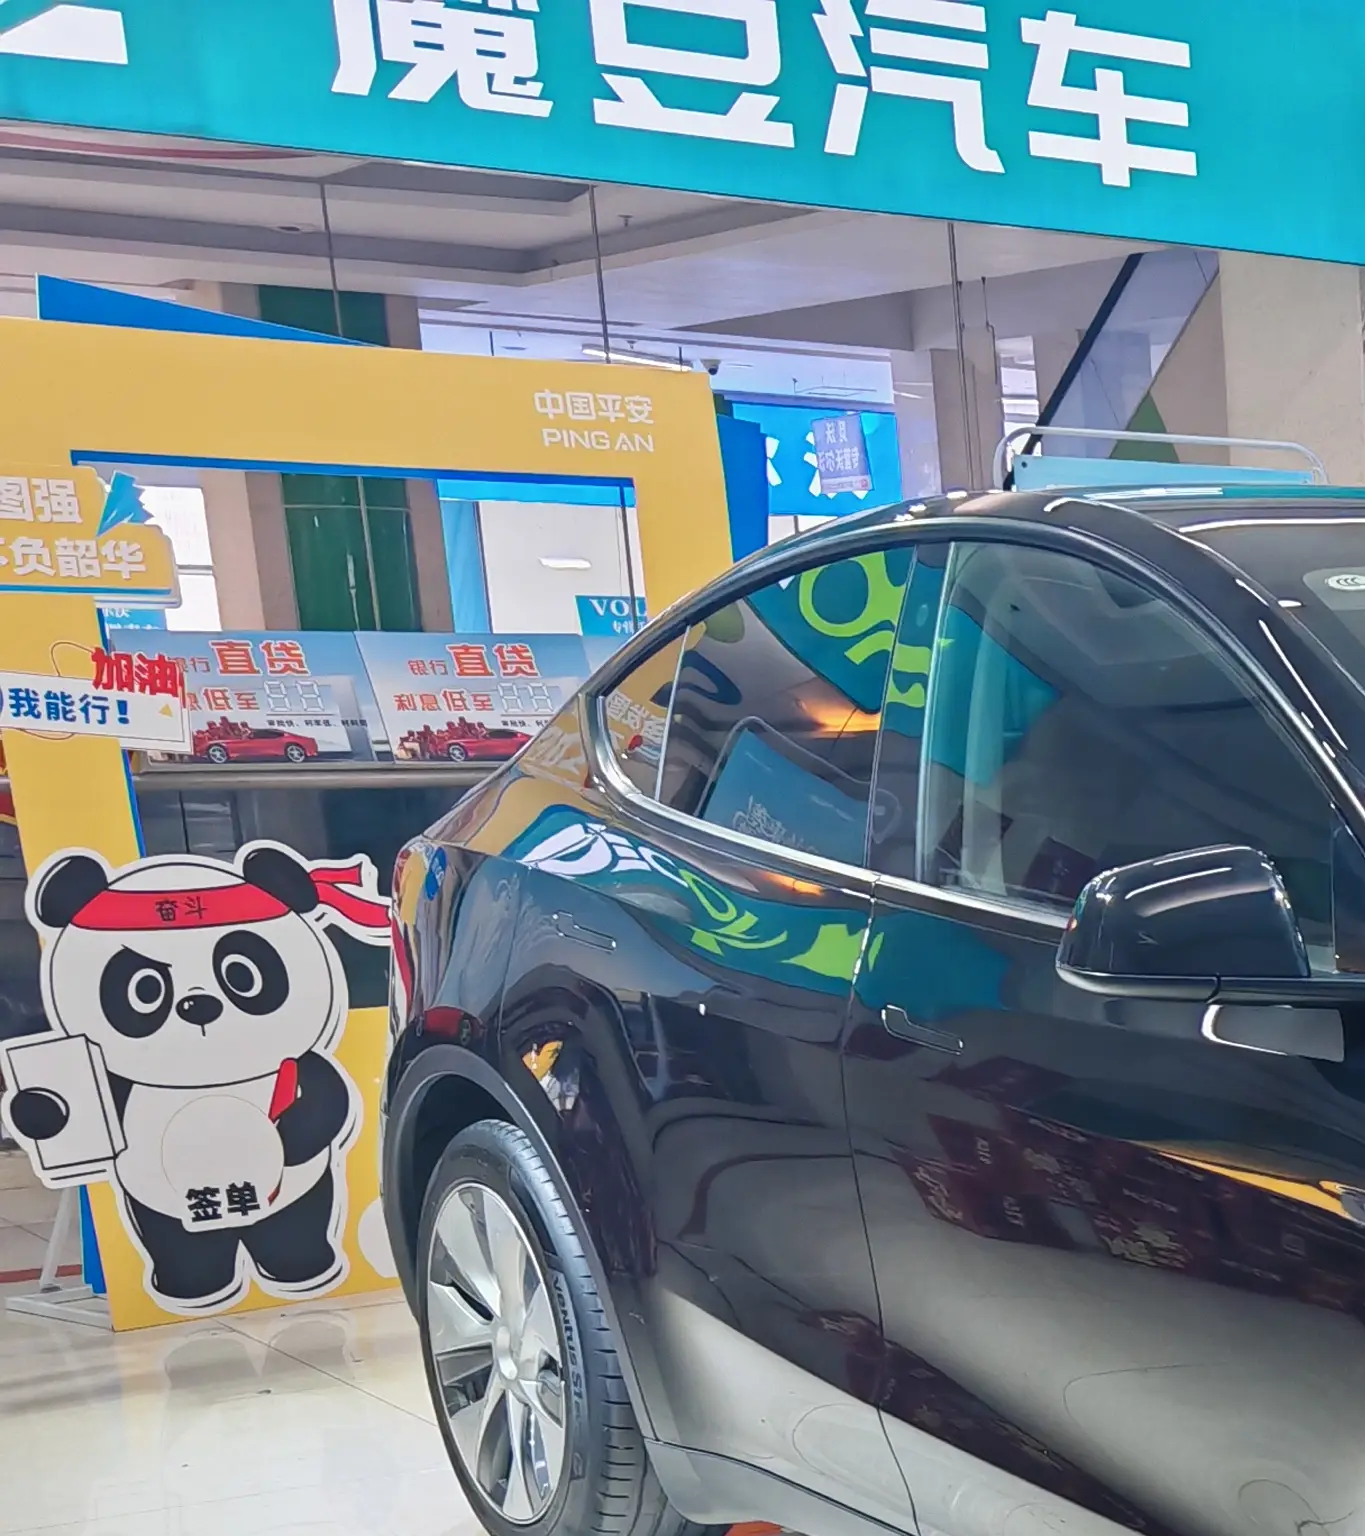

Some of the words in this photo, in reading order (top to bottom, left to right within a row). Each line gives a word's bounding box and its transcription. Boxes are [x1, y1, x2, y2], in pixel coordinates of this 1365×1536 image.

[331, 0, 1198, 188] 魔豆汽车
[534, 388, 654, 424] 中国平安
[0, 536, 146, 579] 负韶华
[91, 646, 181, 697] 加油
[155, 896, 207, 921] 奋斗
[185, 1181, 260, 1223] 签单
